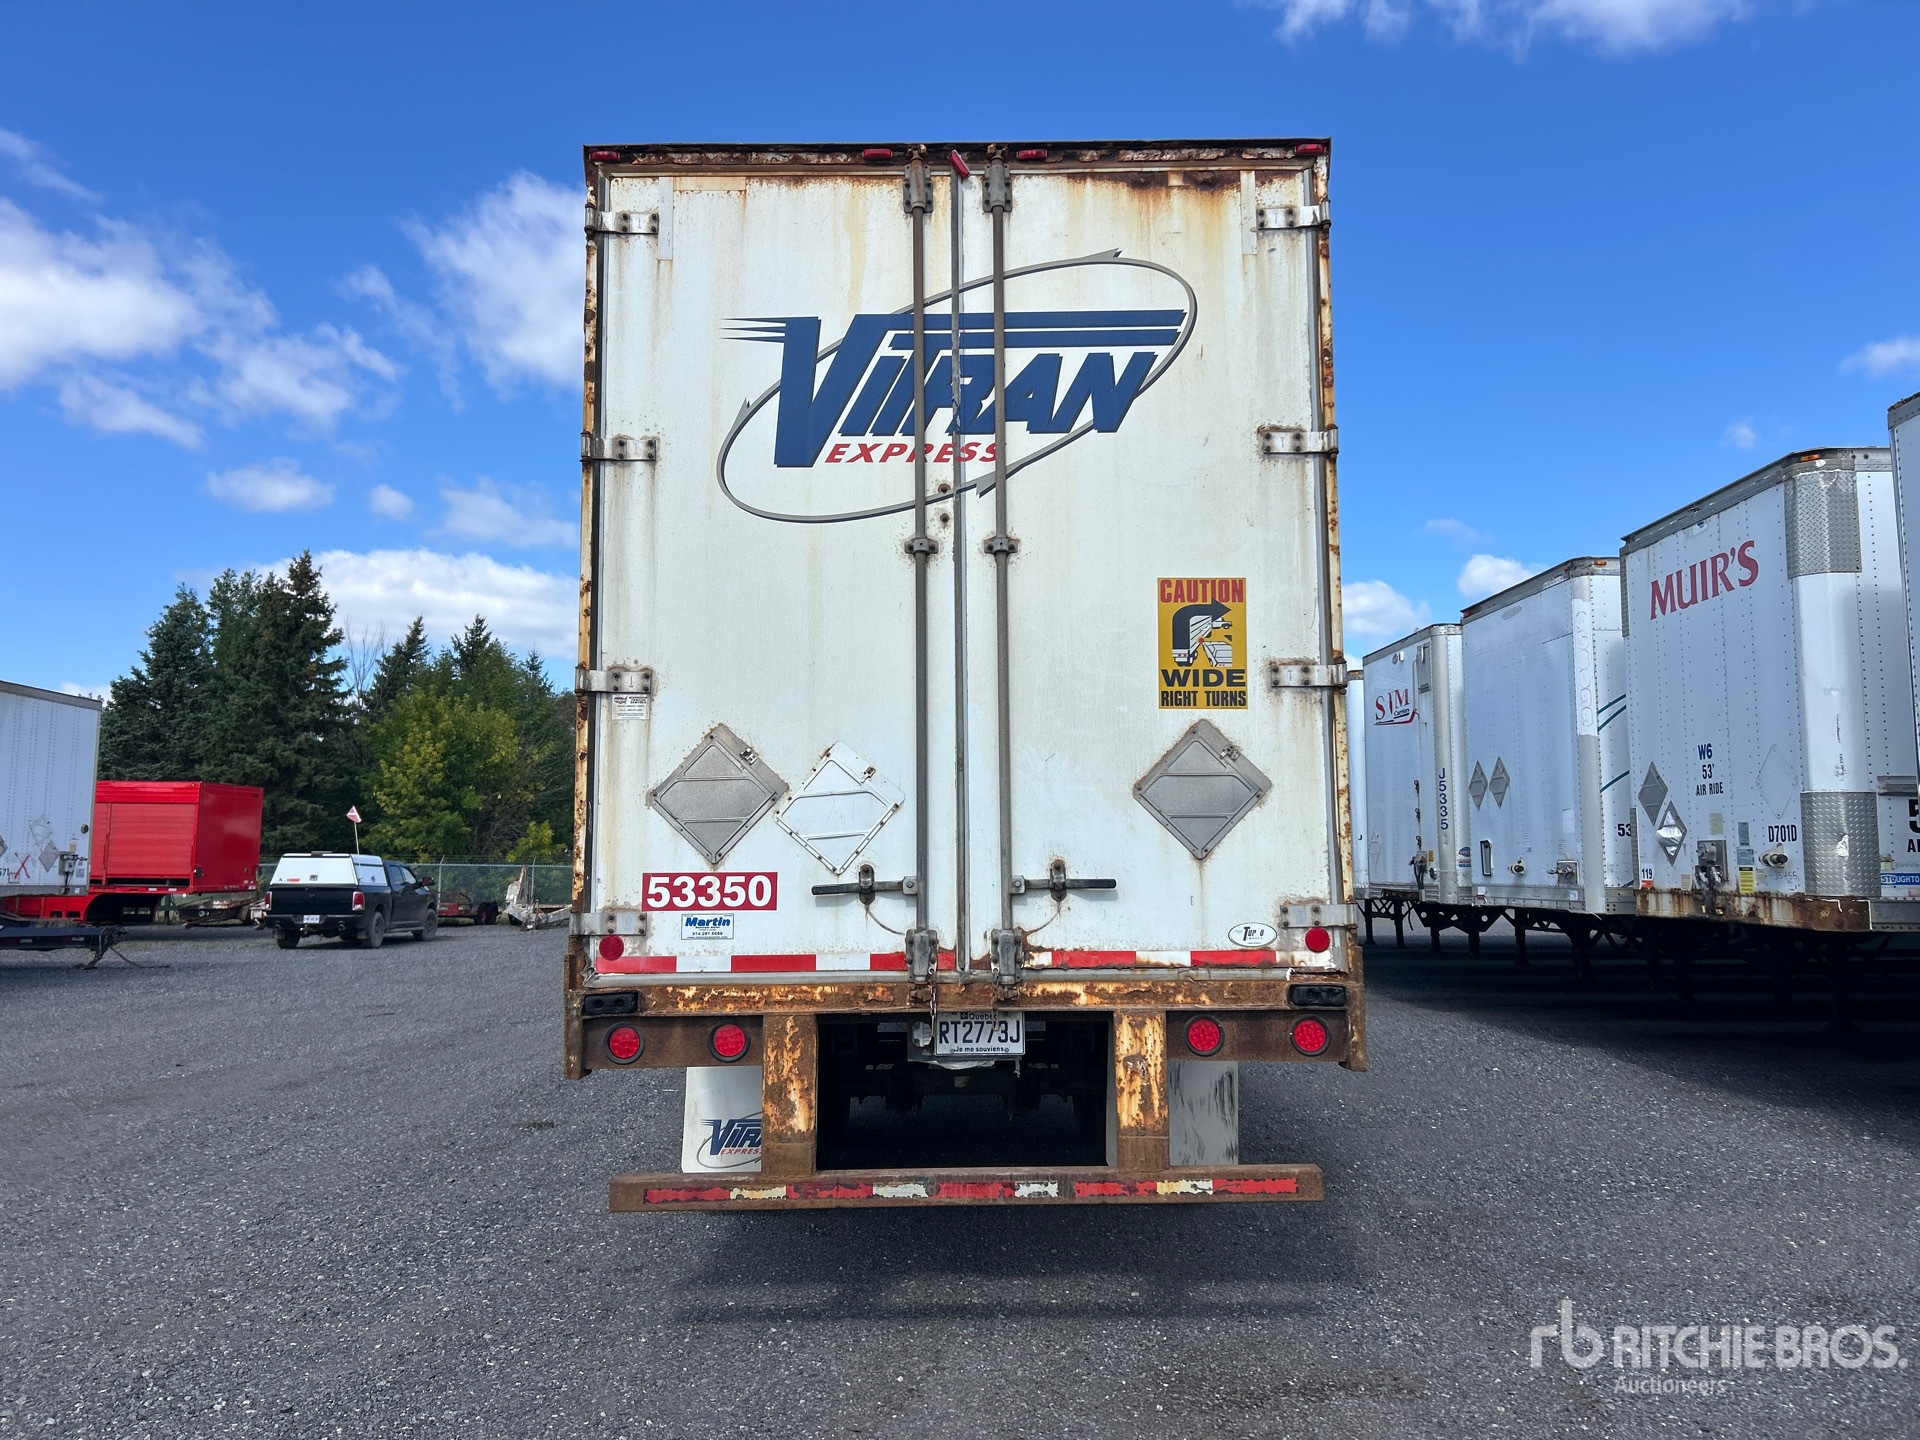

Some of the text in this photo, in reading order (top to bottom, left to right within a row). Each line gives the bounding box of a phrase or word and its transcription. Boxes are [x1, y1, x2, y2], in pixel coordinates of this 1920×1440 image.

[825, 442, 1007, 463] EXPRESS
[1650, 540, 1759, 620] MUIR'S
[1160, 580, 1243, 602] CAUTION
[1161, 669, 1246, 687] WIDE
[1161, 691, 1246, 706] RIGHT TURNS
[1698, 743, 1713, 760] W6
[1702, 763, 1714, 779] 53'
[1696, 782, 1723, 796] AIR RIDE
[1768, 825, 1797, 842] D701D
[1642, 868, 1652, 879] 119
[647, 875, 772, 908] 53350
[685, 917, 731, 926] Martin
[939, 1020, 1020, 1044] RT2773J
